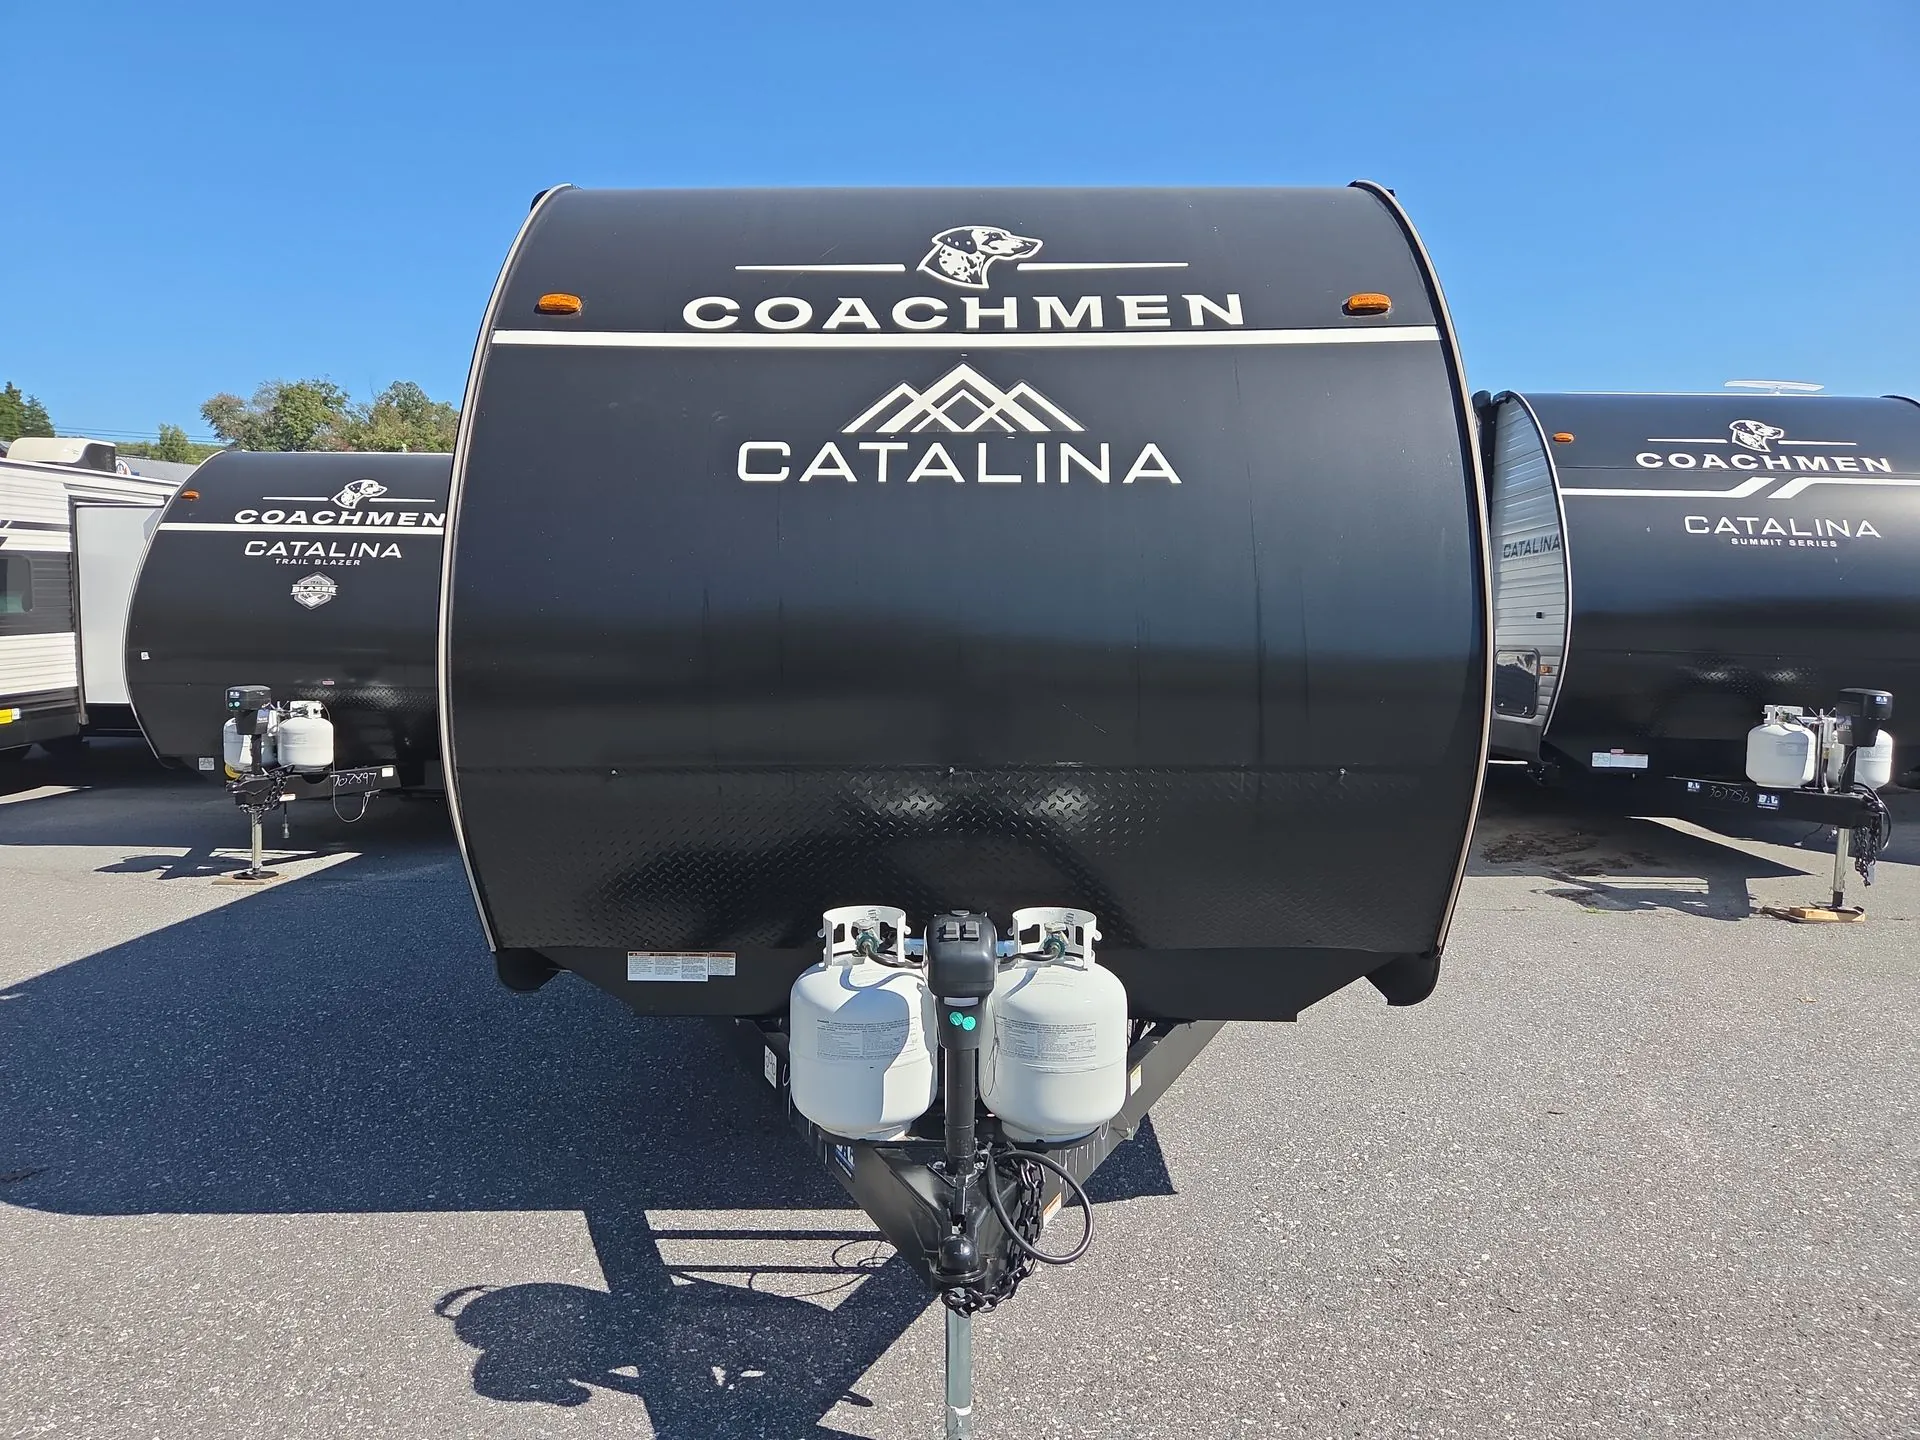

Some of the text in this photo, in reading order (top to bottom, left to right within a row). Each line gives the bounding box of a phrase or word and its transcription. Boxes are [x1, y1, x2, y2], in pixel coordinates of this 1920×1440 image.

[682, 294, 1244, 330] COACHMEN
[737, 441, 1183, 484] CATALINA
[1635, 452, 1893, 473] COACHMEN
[234, 509, 446, 526] COACHMEN
[1684, 515, 1882, 538] CATALINA
[244, 540, 402, 559] CATALINA
[1503, 533, 1561, 558] CATALINA
[1731, 537, 1838, 548] SUMMIT SERIES
[314, 558, 361, 566] BLAZER
